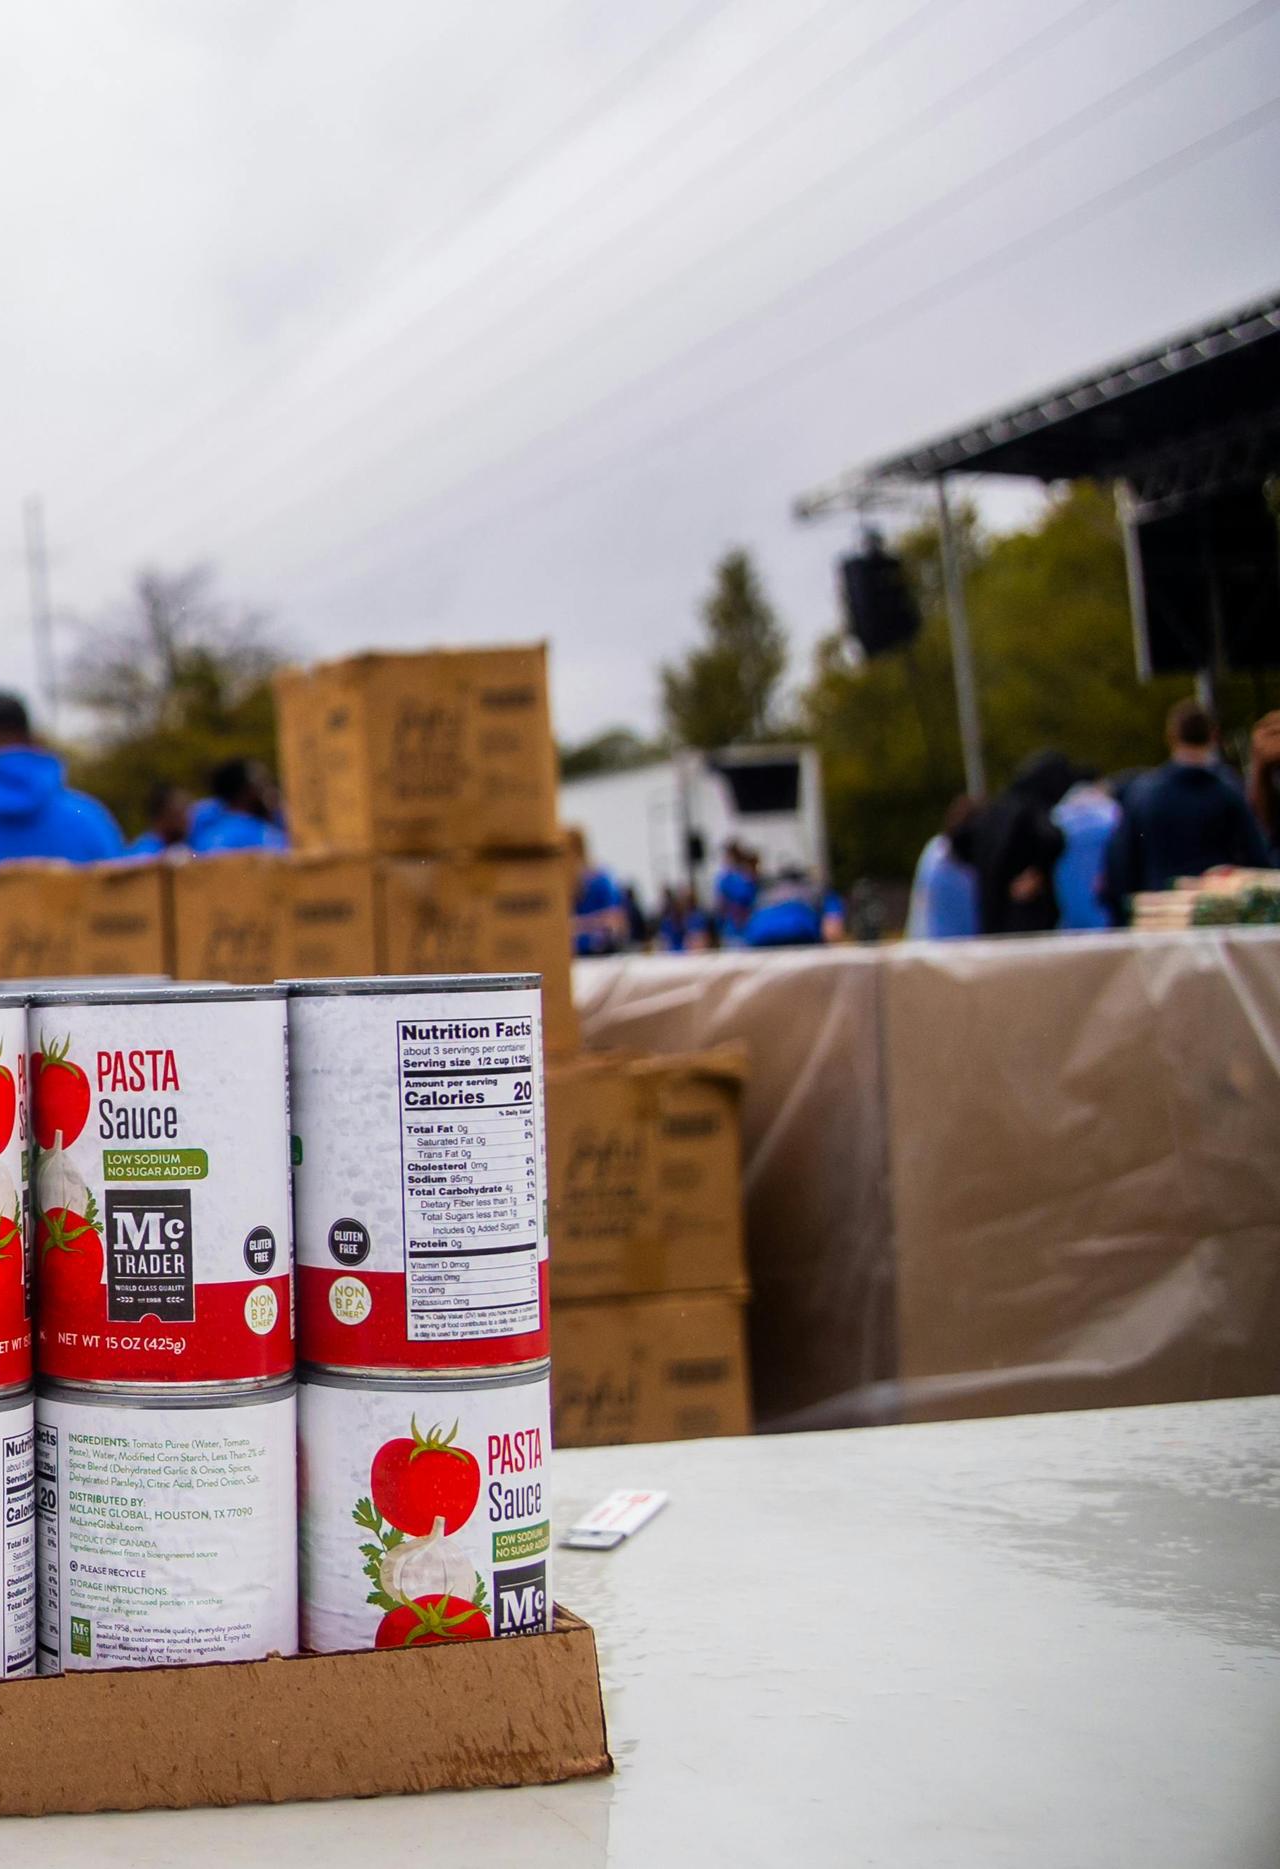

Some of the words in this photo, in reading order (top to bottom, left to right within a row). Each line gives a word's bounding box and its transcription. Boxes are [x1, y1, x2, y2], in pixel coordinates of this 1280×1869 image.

[402, 1023, 490, 1040] Nutrition
[495, 1021, 531, 1037] Facts
[403, 1047, 431, 1056] about
[433, 1046, 440, 1055] 3
[442, 1045, 480, 1056] servings
[482, 1045, 495, 1055] per
[404, 1059, 446, 1069] Serving
[450, 1057, 471, 1066] size
[477, 1057, 491, 1066] 1/2
[494, 1057, 510, 1066] cup
[97, 1050, 180, 1092] PASTA
[405, 1079, 445, 1088] Amount
[447, 1079, 464, 1088] per
[466, 1077, 498, 1087] serving
[405, 1090, 485, 1106] Calories
[514, 1081, 532, 1101] 20
[99, 1098, 178, 1140] Sauce
[407, 1125, 434, 1134] Total
[437, 1125, 453, 1133] Fat
[457, 1124, 468, 1135] 0g
[107, 1154, 131, 1165] LOW
[135, 1154, 181, 1164] SODIUM
[108, 1167, 124, 1178] NO
[126, 1167, 161, 1177] SUGAR
[164, 1166, 201, 1177] ADDED
[408, 1161, 467, 1172] Cholesterol
[471, 1161, 488, 1171] 0mg
[408, 1174, 447, 1184] Sodium
[450, 1174, 473, 1184] 95mg
[409, 1187, 435, 1196] Total
[439, 1185, 502, 1197] Carbohydrate
[334, 1230, 364, 1243] GLUTEN
[248, 1237, 272, 1251] GLUTEN
[340, 1243, 358, 1256] FREE
[114, 1253, 185, 1275] TRADER
[253, 1252, 269, 1263] FREE
[115, 1284, 136, 1292] WORLD
[138, 1284, 157, 1292] CLASS
[334, 1285, 365, 1298] NON
[249, 1294, 273, 1308] NON
[335, 1298, 366, 1311] BPA
[249, 1309, 274, 1321] BPA
[12, 1338, 23, 1351] WT
[58, 1332, 78, 1346] NET
[82, 1333, 100, 1346] WT
[105, 1334, 118, 1347] 15
[120, 1335, 140, 1348] OZ
[143, 1335, 185, 1354] (425g)
[69, 1433, 130, 1448] INGREDIENTS:
[132, 1440, 162, 1450] Tomato
[165, 1440, 189, 1450] Puree
[192, 1438, 221, 1450] (Water,
[223, 1438, 250, 1448] Tomato
[488, 1428, 542, 1476] PASTA
[69, 1491, 128, 1506] DISTRIBUTED
[130, 1498, 145, 1508] BY:
[489, 1482, 541, 1522] Sauce
[69, 1504, 106, 1517] MCLANE
[109, 1508, 151, 1521] GLOBAL,
[155, 1510, 211, 1521] HOUSTON,
[214, 1509, 225, 1519] TX
[227, 1507, 253, 1518] 77090
[69, 1516, 143, 1533] McLaneGlobal.com
[70, 1531, 103, 1546] PRODUCT
[105, 1536, 117, 1546] OF
[119, 1538, 157, 1548] CANADA
[496, 1533, 516, 1547] LOW
[496, 1546, 510, 1557] NO
[511, 1543, 534, 1556] SUGAR
[81, 1564, 106, 1576] PLEASE
[108, 1568, 146, 1579] RECYCLE
[70, 1579, 102, 1592] STORAGE
